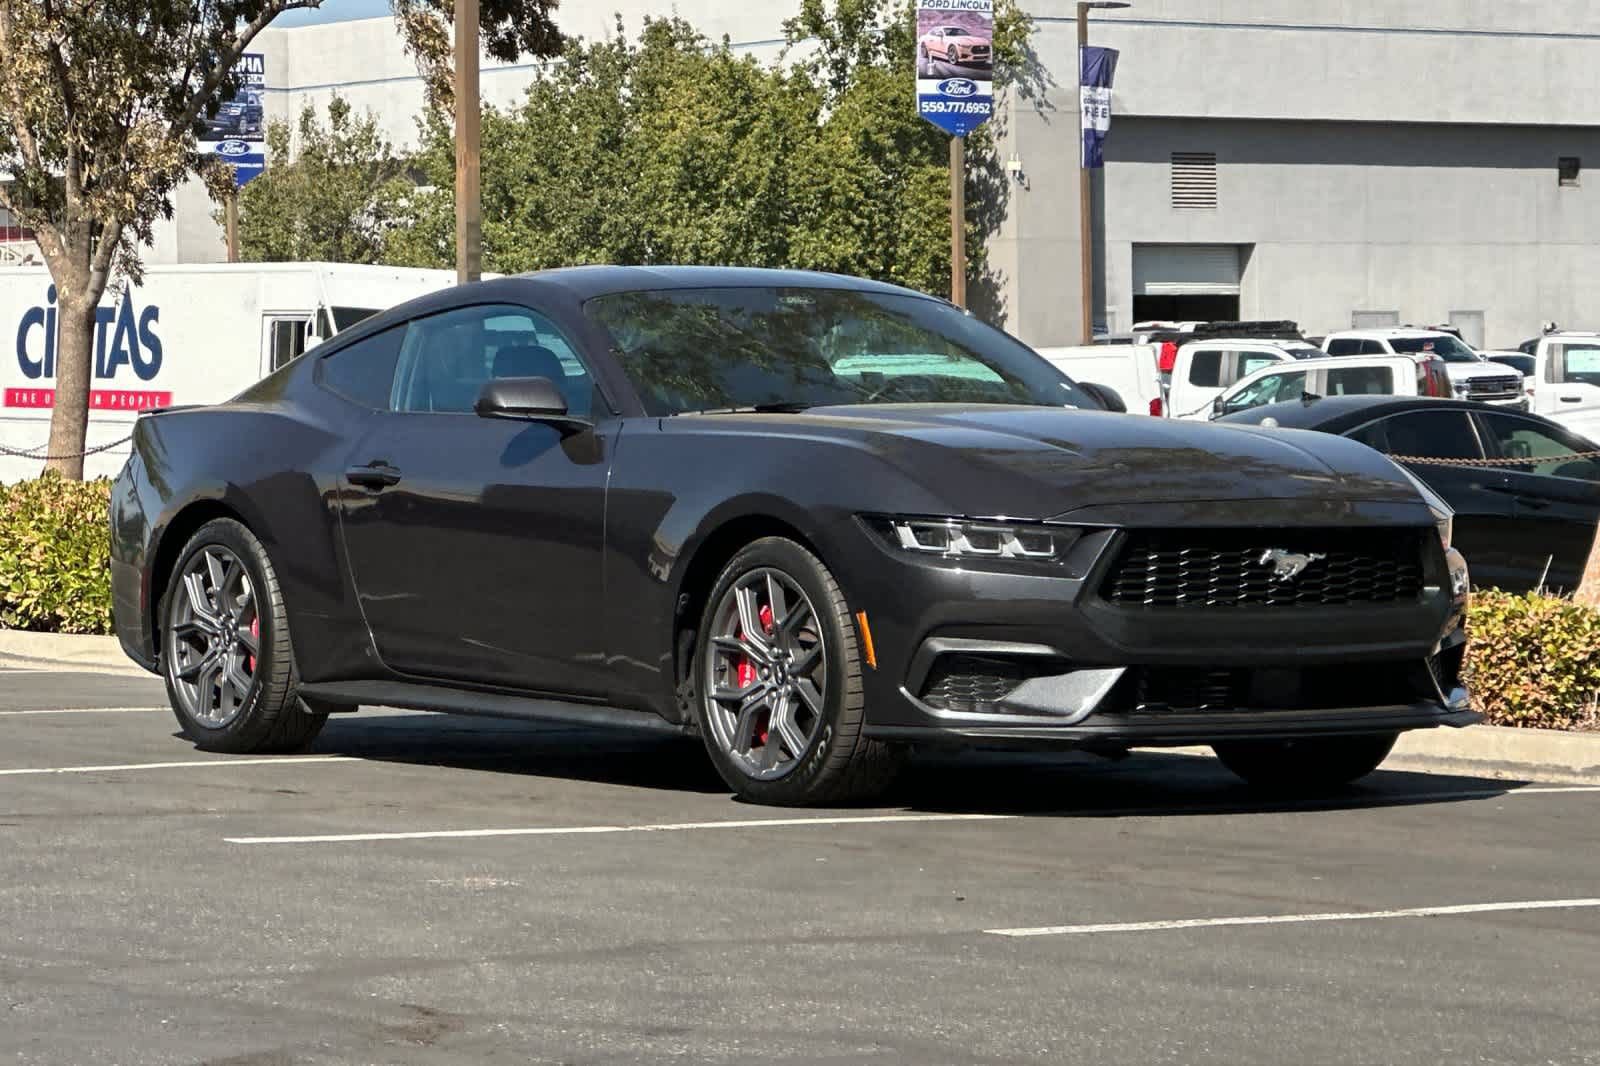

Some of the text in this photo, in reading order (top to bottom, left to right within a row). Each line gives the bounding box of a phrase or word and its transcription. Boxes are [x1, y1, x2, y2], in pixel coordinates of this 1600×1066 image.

[921, 0, 991, 10] FORD LINCOLN
[945, 80, 972, 94] Ford
[921, 101, 991, 114] 559.777.6952
[222, 140, 246, 153] Ford
[16, 279, 163, 381] CiTAS
[15, 393, 36, 404] THE
[111, 396, 161, 408] PEOPLE
